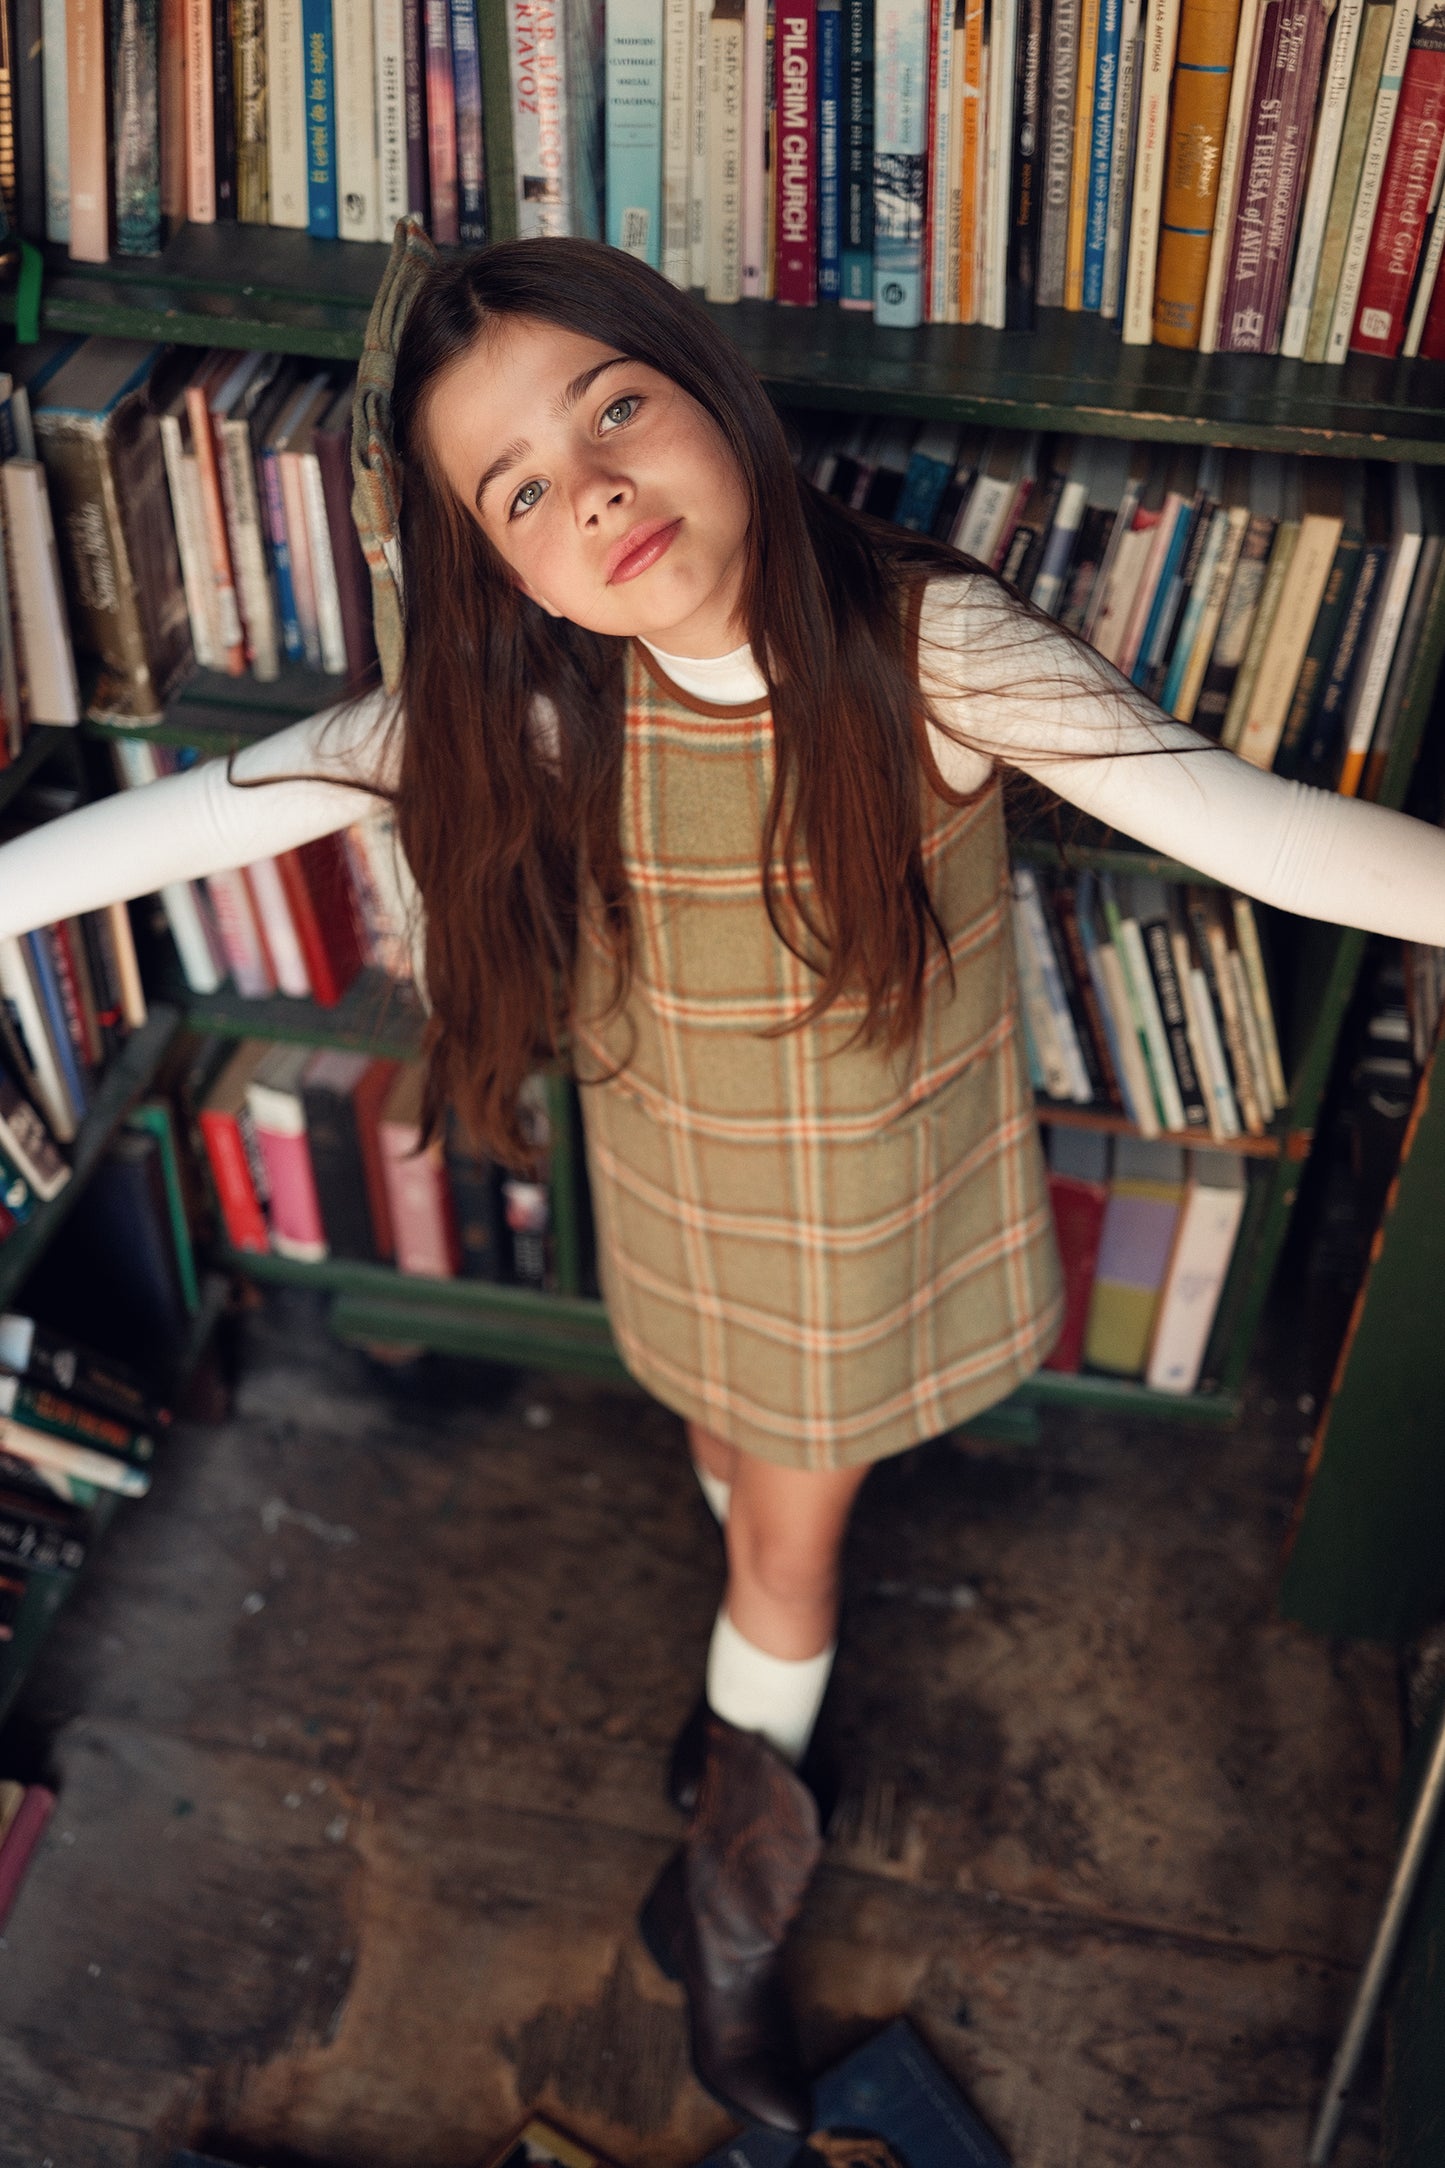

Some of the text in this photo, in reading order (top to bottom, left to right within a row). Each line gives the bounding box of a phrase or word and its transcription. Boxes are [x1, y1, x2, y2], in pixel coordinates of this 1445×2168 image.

[1279, 17, 1292, 33] of
[1388, 8, 1410, 72] Goldsmith
[309, 32, 328, 73] sapos
[1122, 39, 1134, 62] The
[1150, 24, 1165, 73] ANTIGUAS
[1287, 35, 1304, 72] Teresa
[1327, 5, 1359, 109] Patterns Plus
[308, 79, 326, 100] los
[1098, 54, 1116, 111] BLANCA
[1118, 65, 1133, 124] Schemer
[308, 104, 327, 122] de
[783, 18, 808, 243] PILGRIM CHURCH
[309, 125, 328, 166] cartel
[1097, 114, 1112, 159] MAGIA
[1117, 127, 1128, 151] and
[1116, 154, 1127, 175] the
[1245, 130, 1278, 201] TERESA
[1398, 118, 1440, 225] Crucified
[1238, 207, 1264, 225] of
[1266, 141, 1296, 249] AUTOBIOGRAPHY
[1338, 96, 1394, 320] LIVING BETWEEN TWO WORLDS
[1234, 228, 1262, 281] AVILA
[1387, 230, 1417, 276] God
